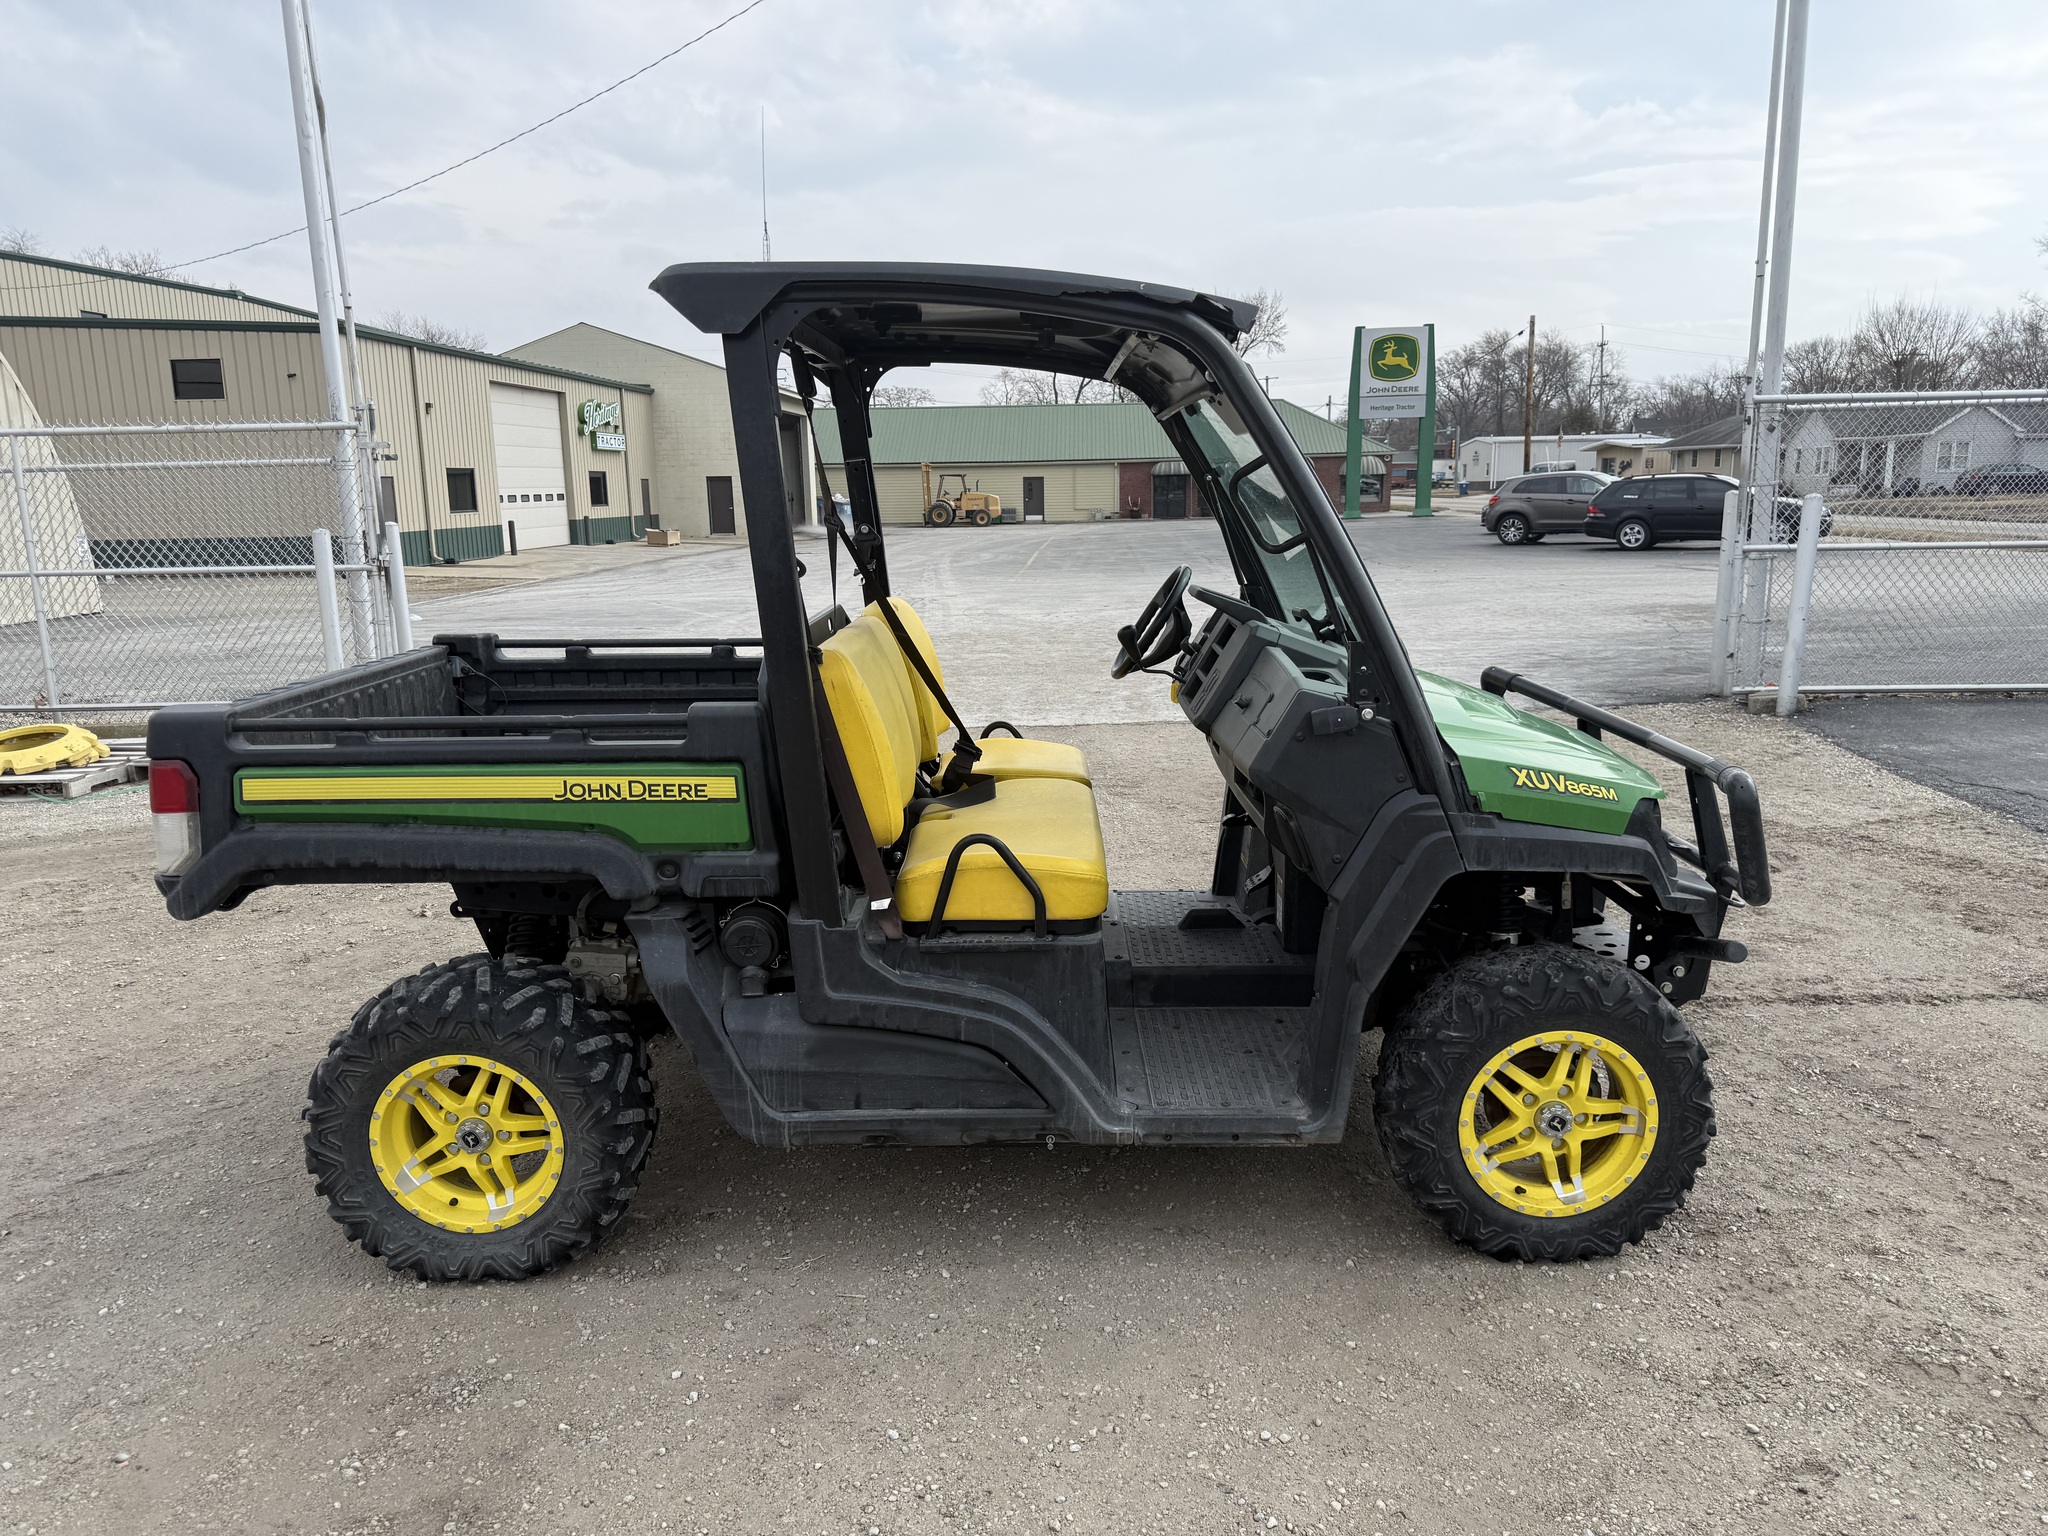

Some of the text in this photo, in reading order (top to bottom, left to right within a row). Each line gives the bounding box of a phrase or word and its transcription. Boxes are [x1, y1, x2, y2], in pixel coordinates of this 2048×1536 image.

[584, 399, 619, 435] Heritage
[597, 436, 625, 447] TRACTOR
[554, 779, 708, 799] JOHN DEERE
[1508, 766, 1619, 802] XUV865M
